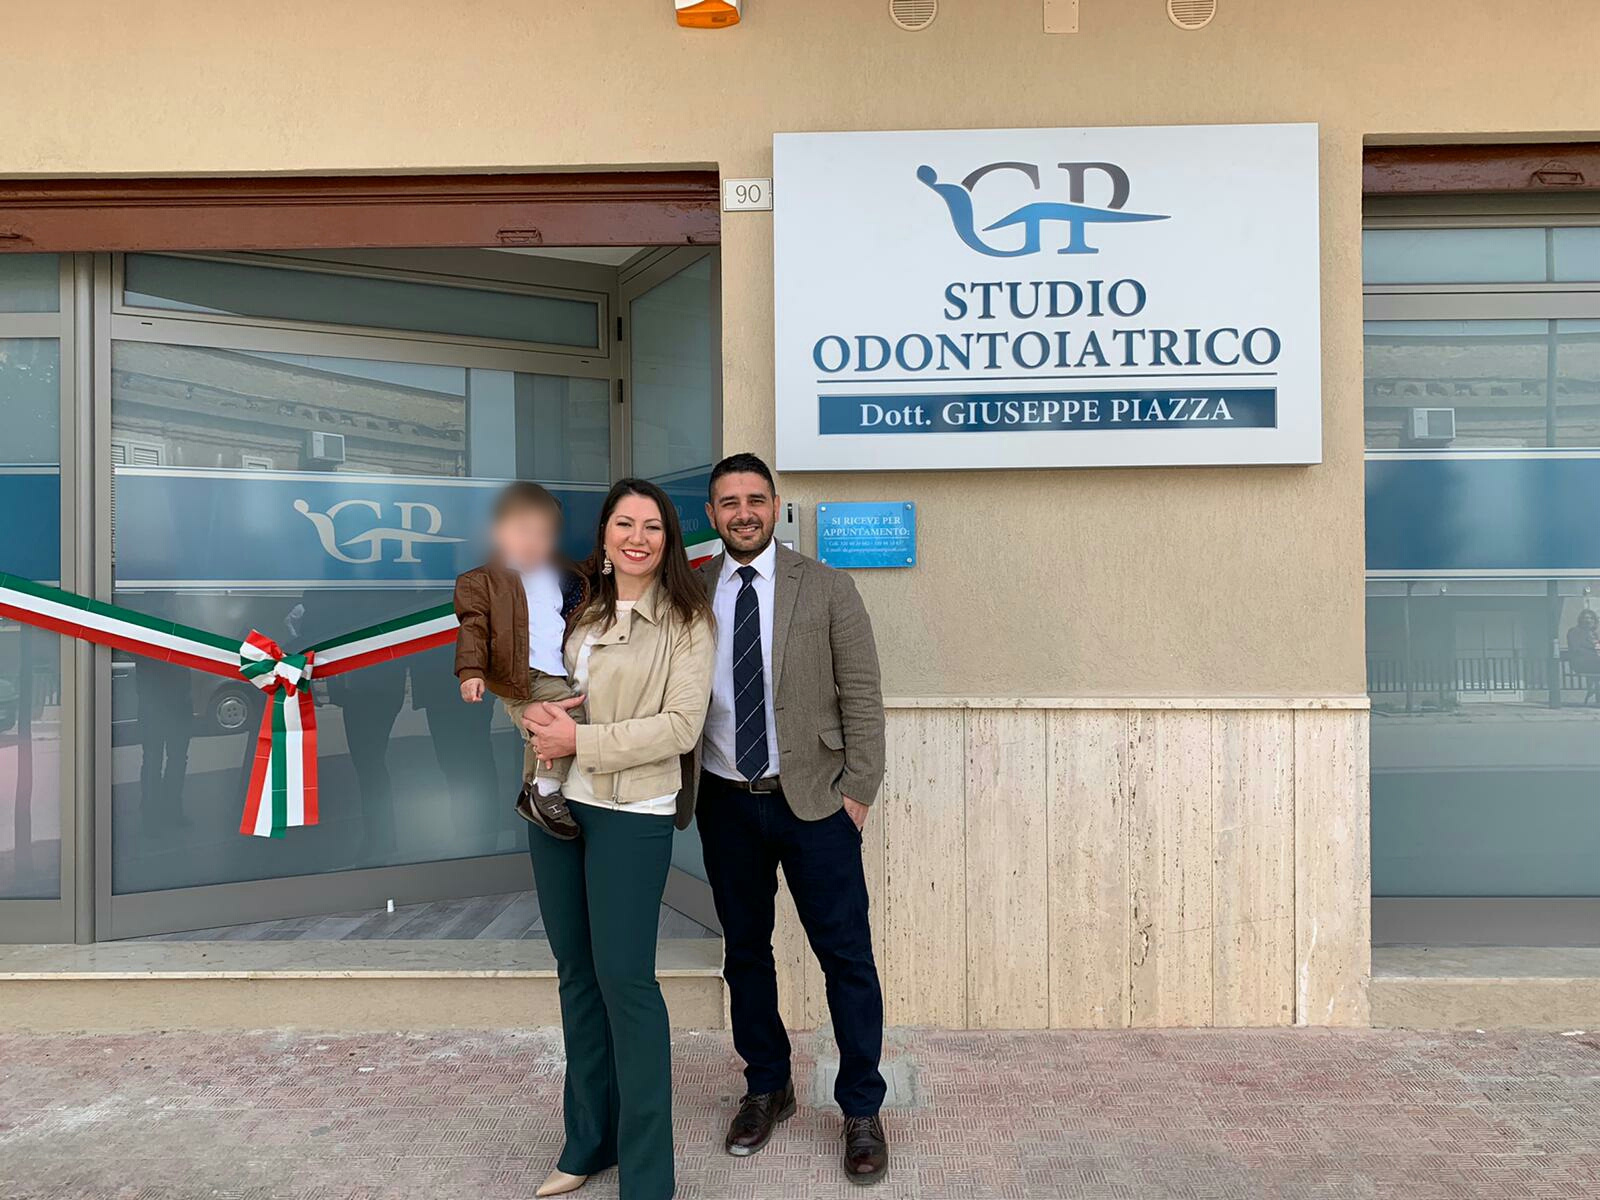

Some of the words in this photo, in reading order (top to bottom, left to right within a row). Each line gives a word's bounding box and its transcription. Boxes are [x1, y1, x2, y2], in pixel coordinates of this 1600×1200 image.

[735, 184, 762, 204] 90
[943, 278, 1147, 321] STUDIO
[812, 327, 1281, 373] ODONTOIATRICO
[859, 403, 932, 426] Dott.
[942, 399, 1101, 425] GIUSEPPE
[1110, 397, 1234, 422] PIAZZA
[823, 528, 910, 536] APPUNTAMENTO:
[832, 517, 841, 525] SI
[844, 517, 880, 525] RICEVE
[882, 516, 900, 525] PER
